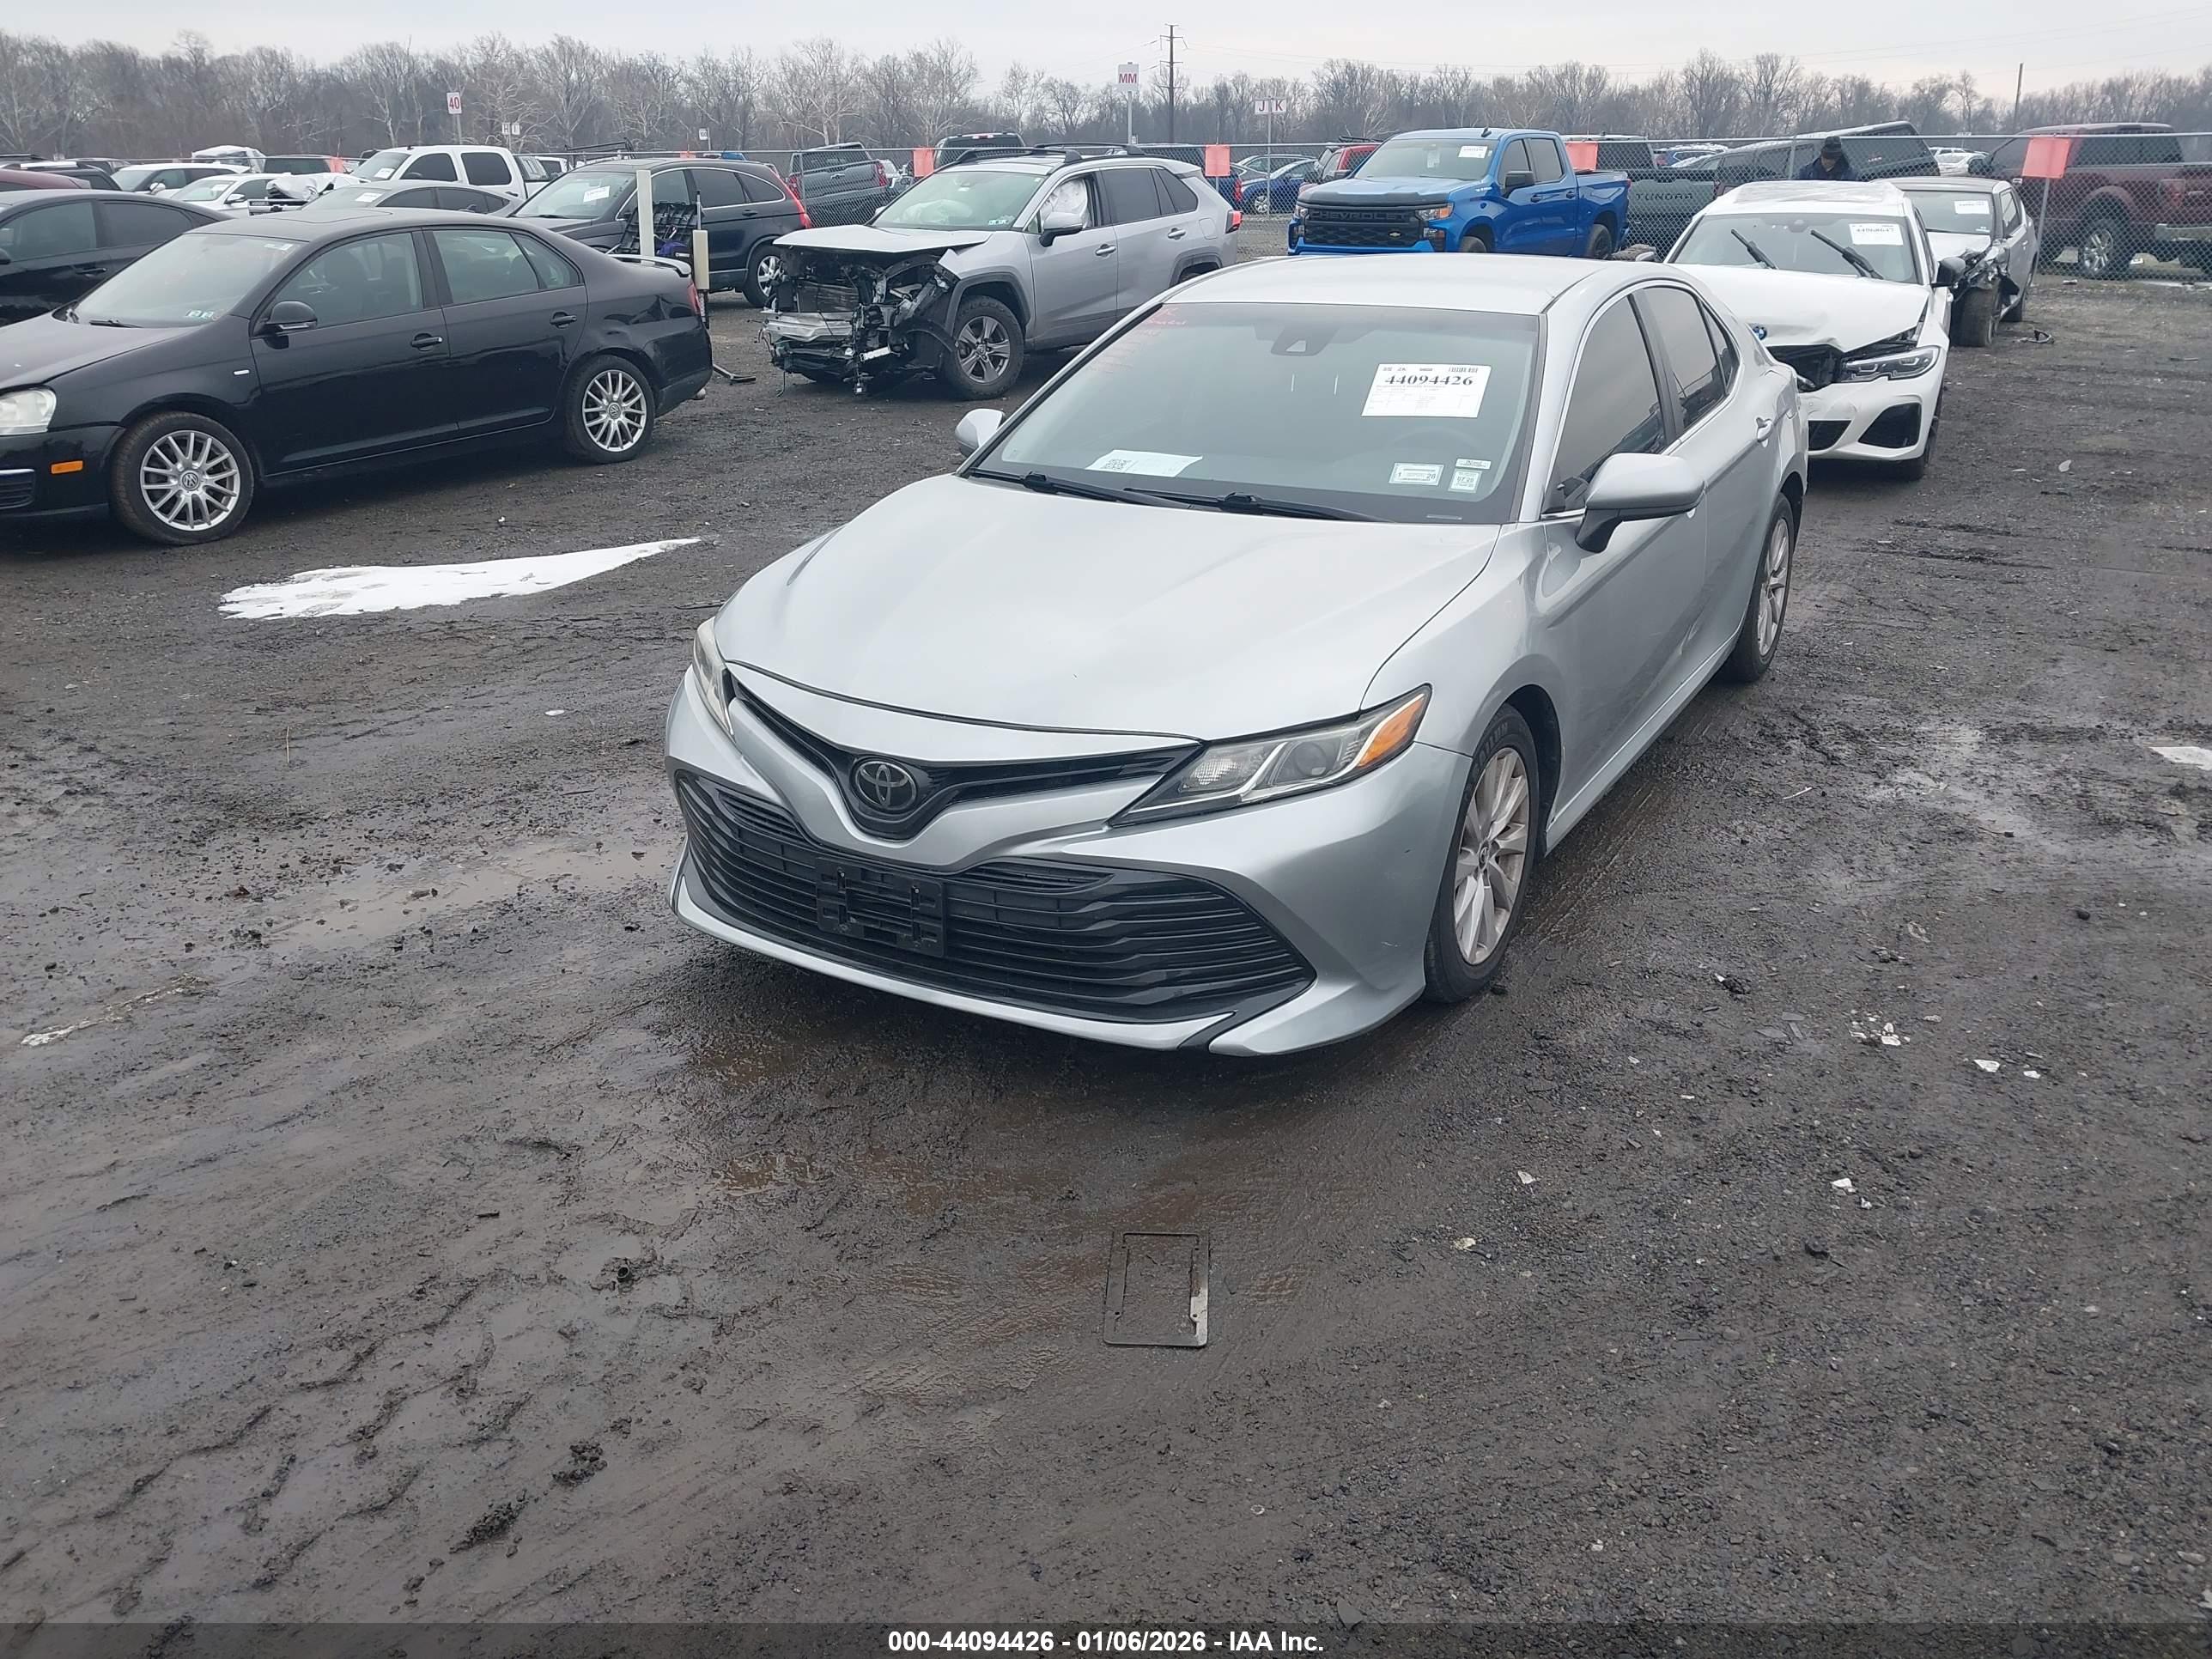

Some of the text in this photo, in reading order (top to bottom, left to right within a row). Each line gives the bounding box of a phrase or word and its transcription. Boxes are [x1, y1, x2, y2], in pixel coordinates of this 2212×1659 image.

[1119, 73, 1137, 83] MM
[449, 96, 460, 109] 40
[1275, 99, 1283, 111] K
[1310, 211, 1408, 221] CHEVROLET
[1384, 374, 1474, 386] 44094426
